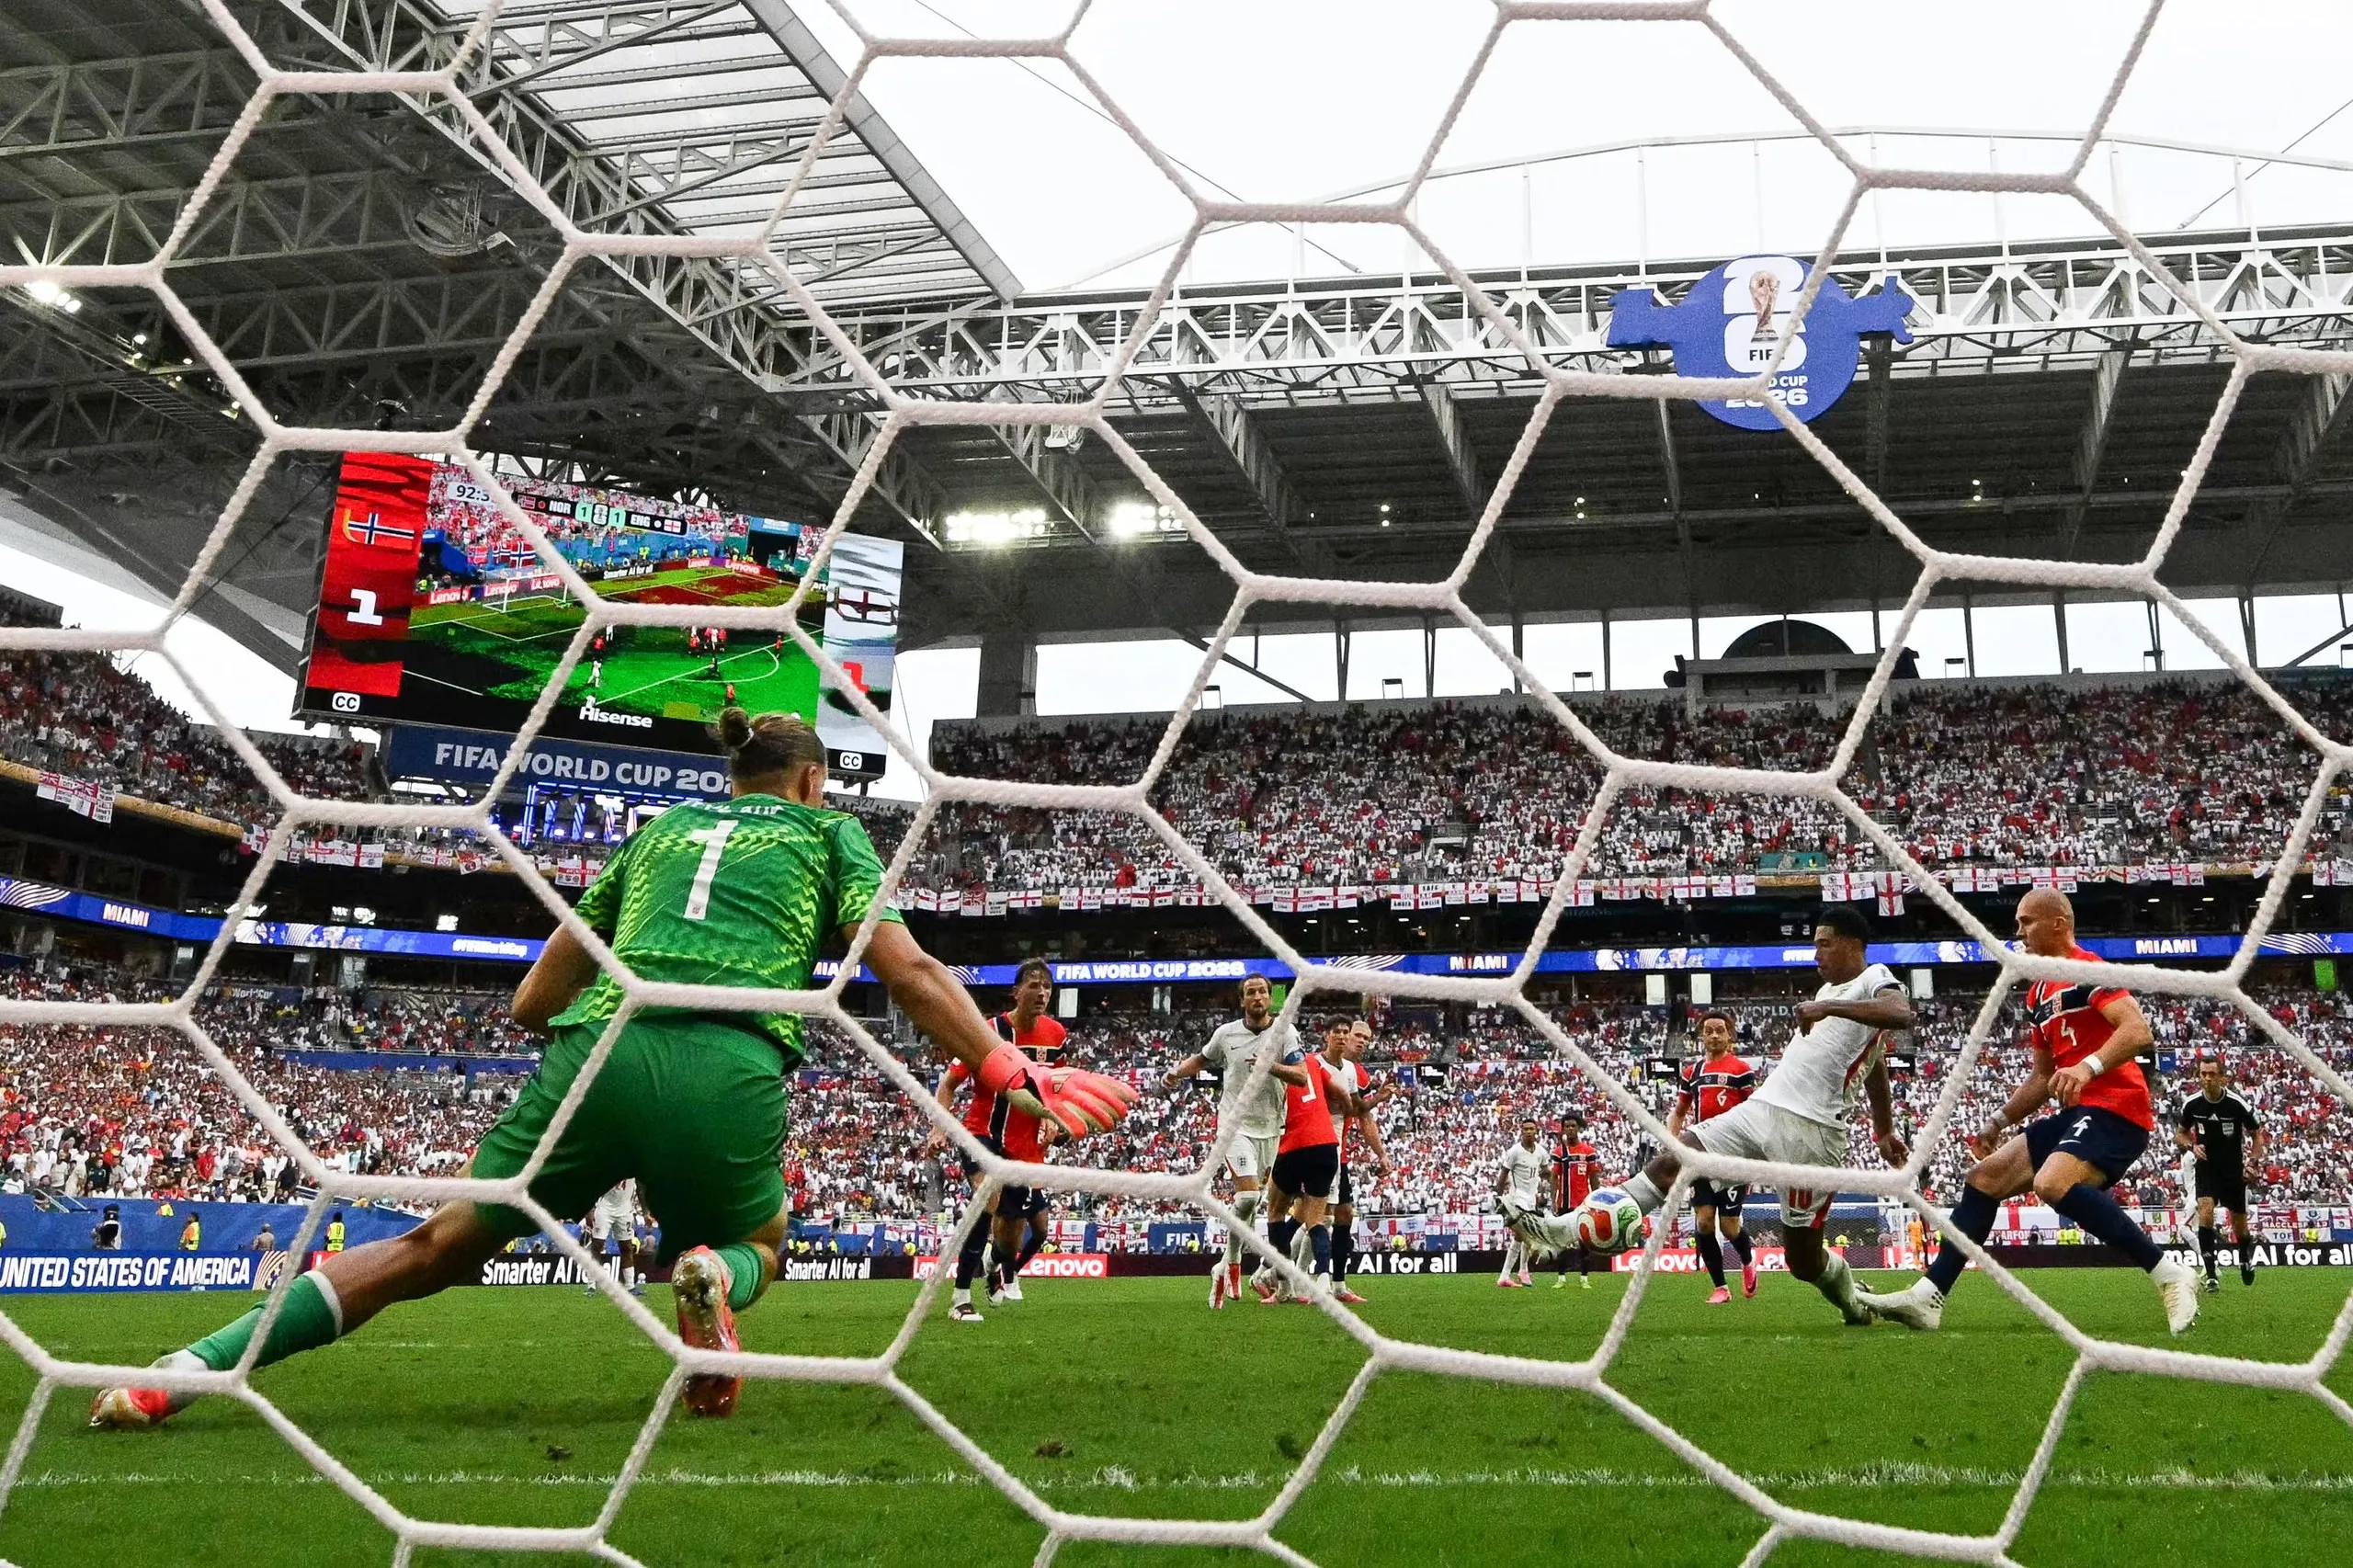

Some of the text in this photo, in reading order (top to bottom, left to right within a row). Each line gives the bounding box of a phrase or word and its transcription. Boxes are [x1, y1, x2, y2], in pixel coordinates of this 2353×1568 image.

[1749, 349, 1785, 361] FIF
[1779, 375, 1808, 387] CUP
[550, 500, 651, 528] NOR 1 1 ENG
[725, 558, 760, 575] Lenovo
[430, 588, 469, 605] Lenovo
[484, 581, 520, 597] Lenovo
[347, 588, 383, 626] 1
[335, 696, 358, 710] CC
[579, 706, 653, 728] Hisense
[435, 743, 498, 772] FIFA
[615, 762, 671, 789] CUP
[676, 768, 733, 794] 20
[842, 755, 860, 767] CC
[855, 797, 875, 808] 327
[683, 820, 739, 920] 1
[103, 903, 150, 927] MIAMI
[2135, 939, 2198, 954] MIAMI
[1056, 965, 1091, 980] FIFA
[1092, 963, 1153, 980] WORLD
[1153, 963, 1187, 979] CUP
[1449, 955, 1507, 971] MIAMI
[2061, 1017, 2077, 1047] 4
[1716, 1088, 1728, 1107] 6
[2072, 1115, 2092, 1137] 4
[1727, 1186, 1738, 1202] 6
[1104, 1232, 1141, 1241] NORWICH
[1357, 1254, 1382, 1274] AI
[1390, 1252, 1425, 1274] for
[1430, 1252, 1458, 1273] all
[2252, 1244, 2278, 1266] AI
[2285, 1244, 2321, 1266] for
[0, 1257, 250, 1288] UNITED STATES OF AMERICA
[482, 1257, 551, 1285] Smarter
[552, 1256, 574, 1283] AI
[785, 1256, 871, 1280] Smarter AI for all
